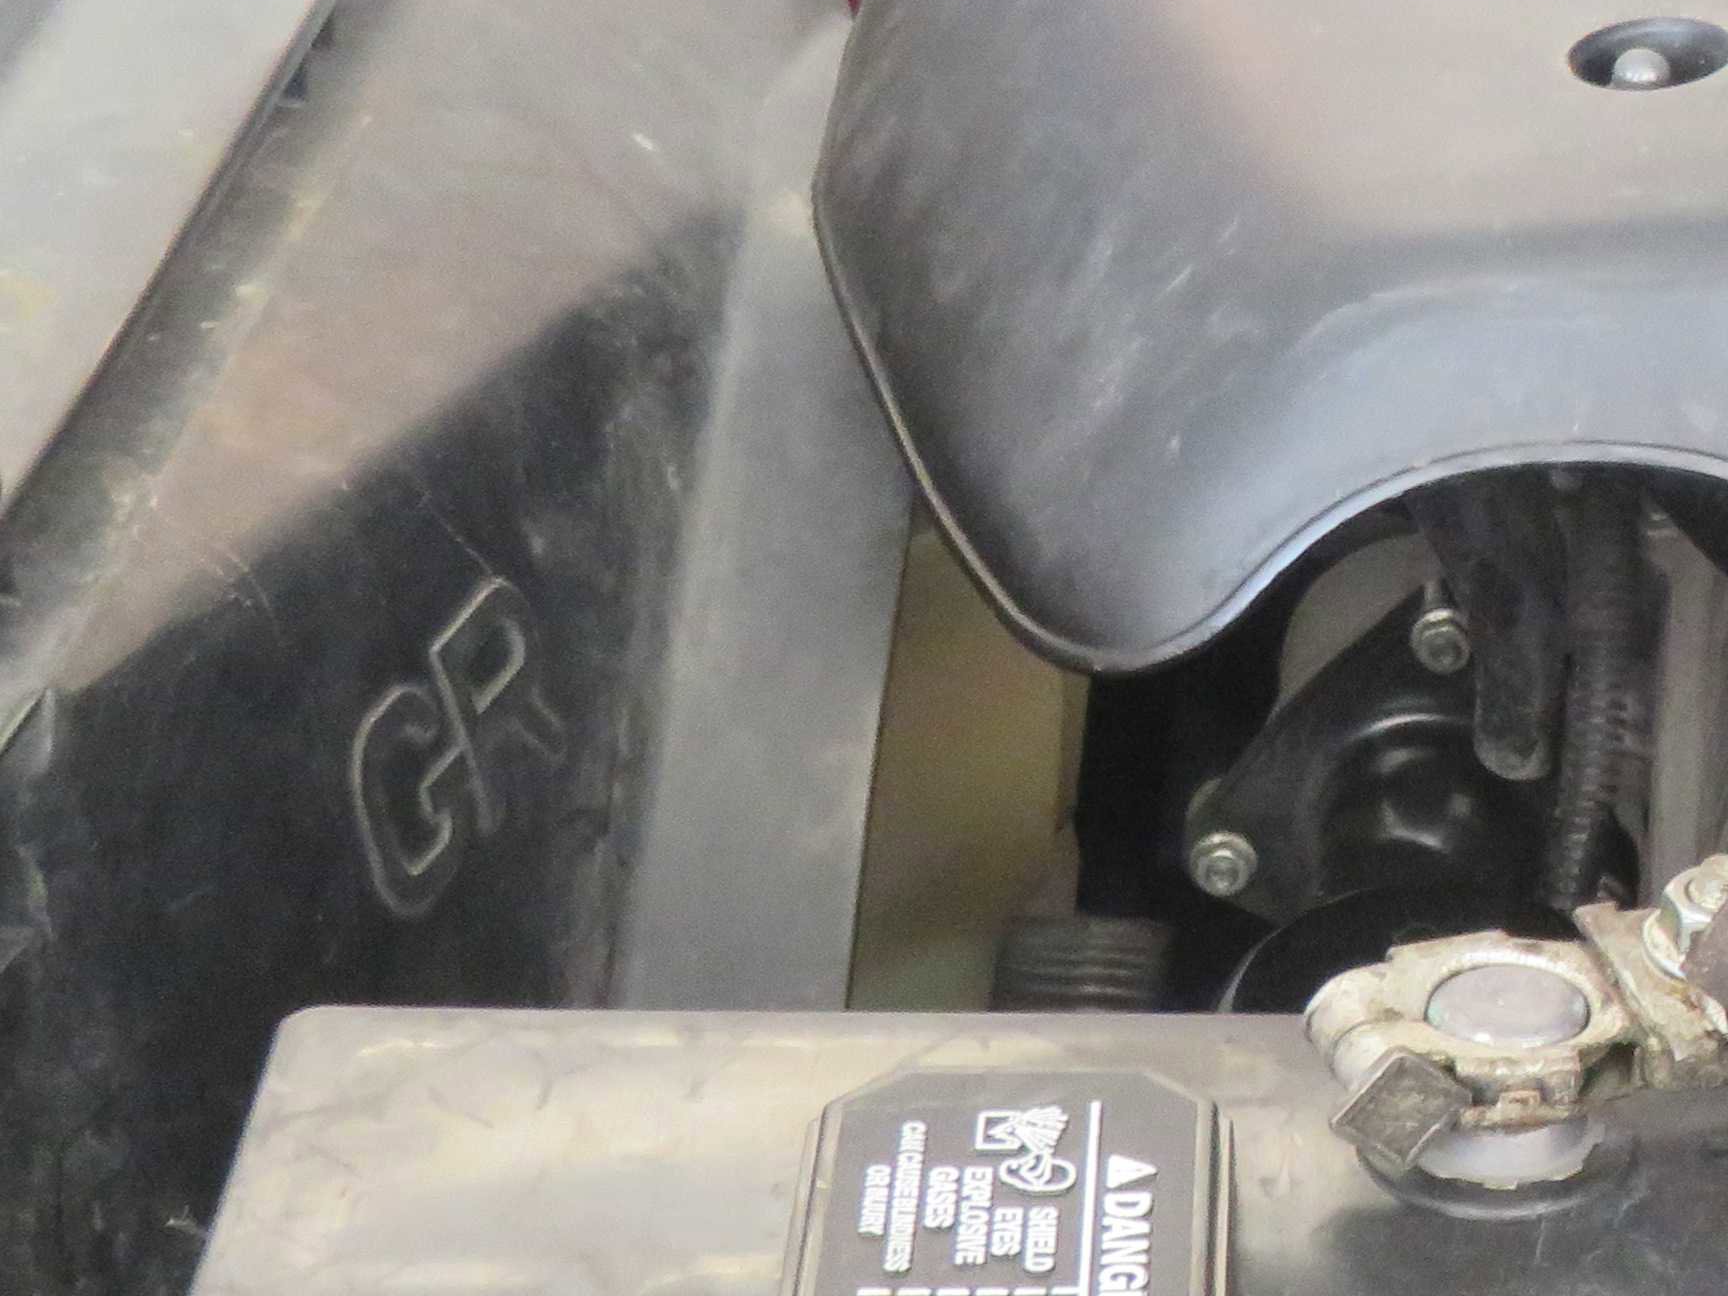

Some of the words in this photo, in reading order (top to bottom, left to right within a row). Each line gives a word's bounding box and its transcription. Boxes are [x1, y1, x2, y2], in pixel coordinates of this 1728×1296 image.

[899, 1120, 927, 1151] CAN
[865, 1164, 891, 1185] OR
[893, 1151, 924, 1194] CAUSE
[924, 1166, 960, 1229] GASES
[857, 1185, 889, 1237] INJURY
[954, 1165, 993, 1265] EXPLOSIVE
[989, 1206, 1025, 1257] EYES
[1024, 1205, 1059, 1273] SHIELD
